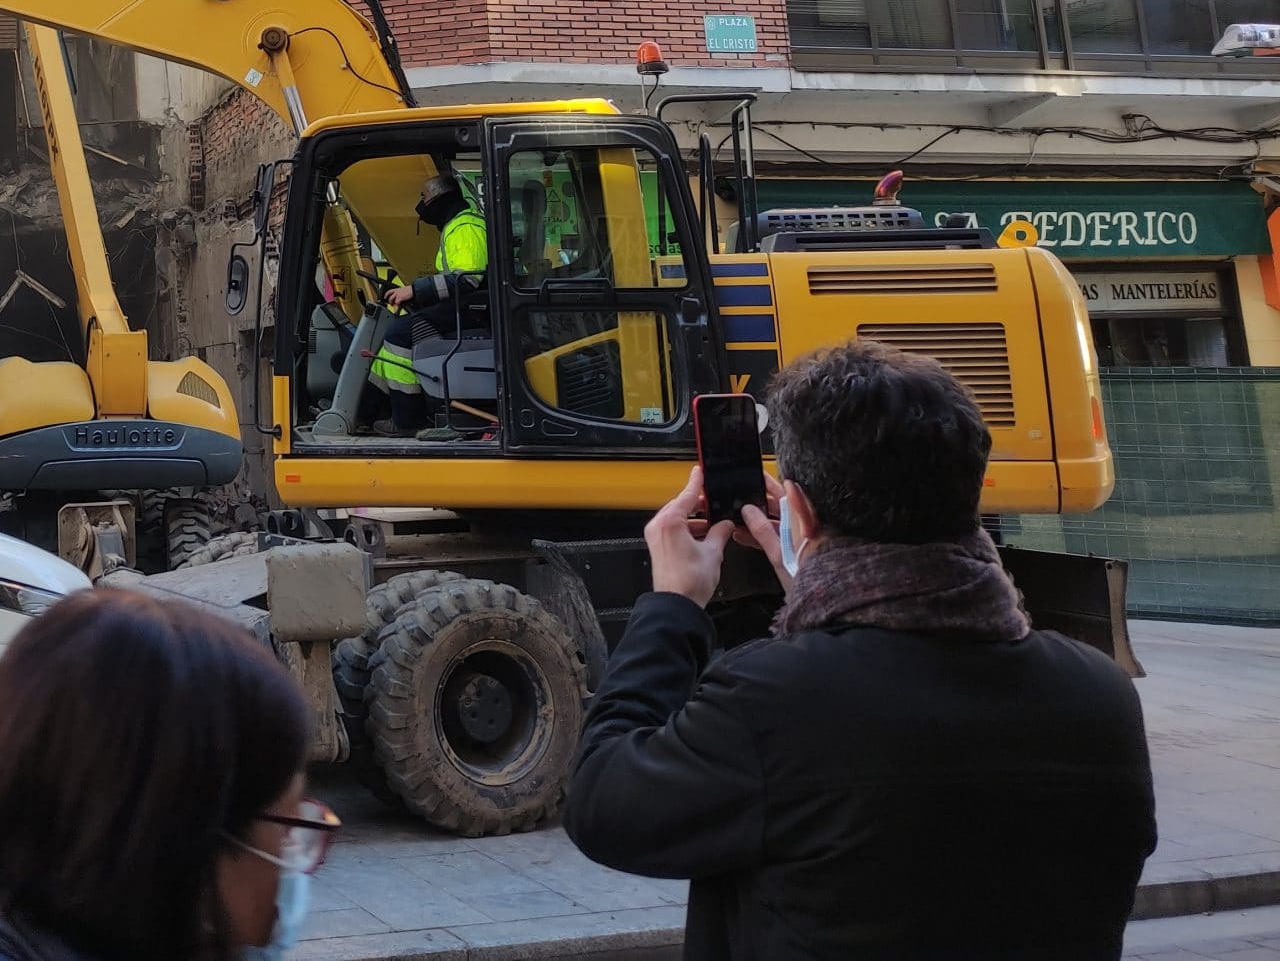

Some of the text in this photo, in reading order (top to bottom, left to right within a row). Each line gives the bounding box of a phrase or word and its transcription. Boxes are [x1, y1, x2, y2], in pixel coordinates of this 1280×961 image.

[719, 18, 748, 27] PLAZA
[709, 38, 755, 49] EL CRISTO
[1111, 279, 1218, 301] MANTELERÍAS
[74, 425, 176, 445] Haulotte
